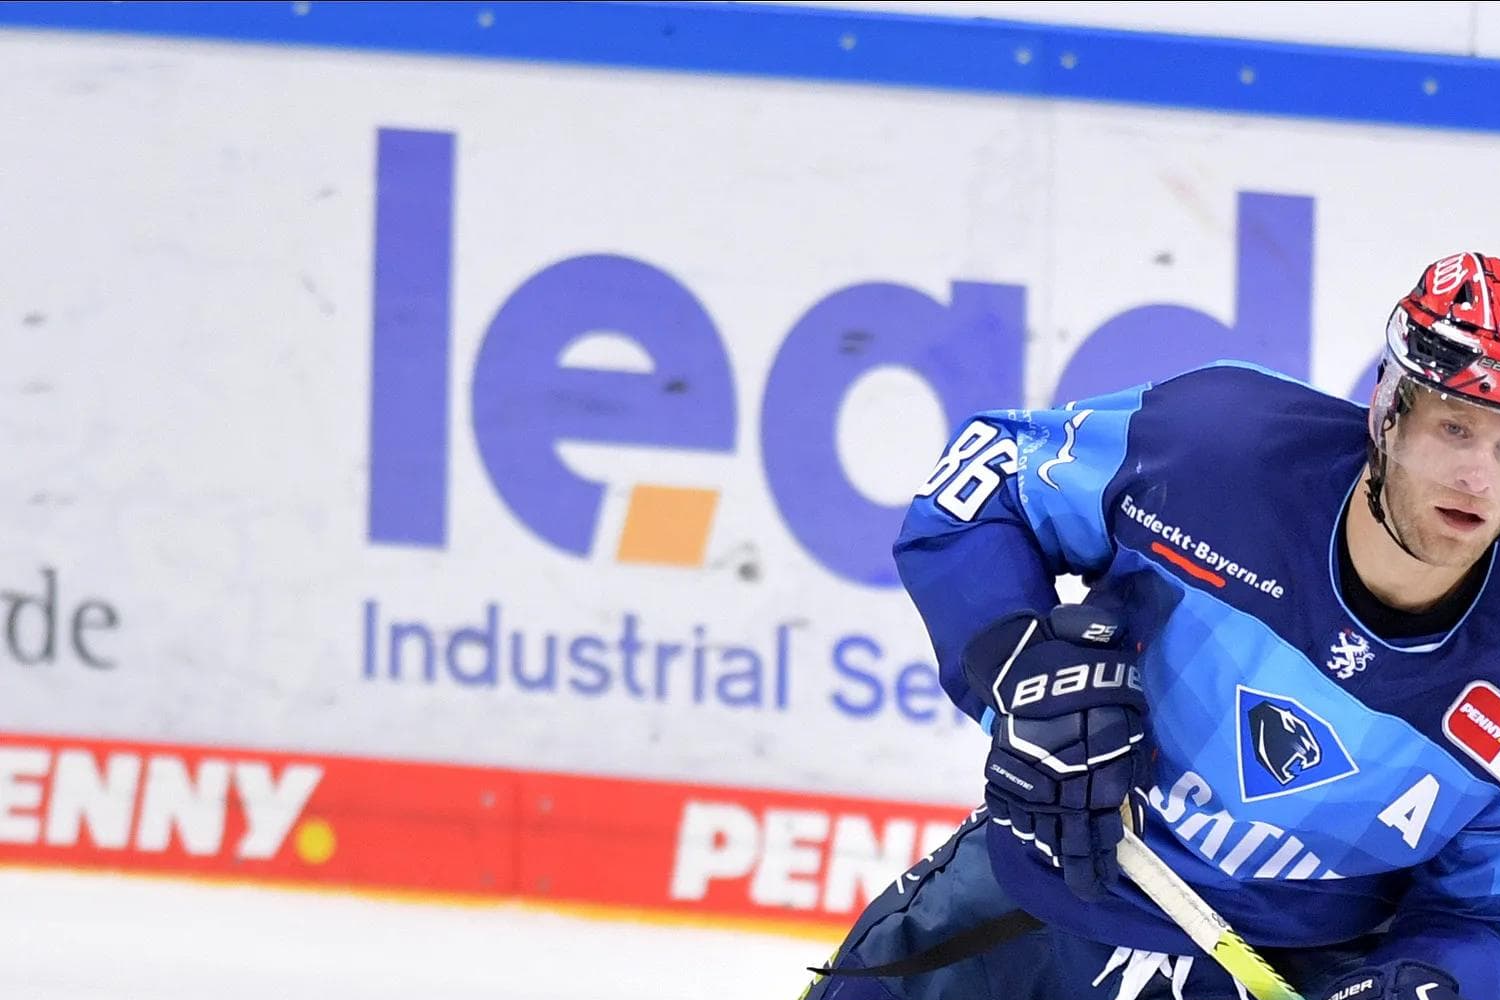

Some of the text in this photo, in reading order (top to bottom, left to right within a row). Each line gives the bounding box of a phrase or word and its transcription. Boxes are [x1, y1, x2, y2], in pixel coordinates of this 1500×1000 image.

[913, 419, 1019, 522] 86
[1120, 494, 1284, 599] Entdeckt-Bayern.de
[361, 599, 966, 728] Industrial Se
[1377, 772, 1440, 850] A
